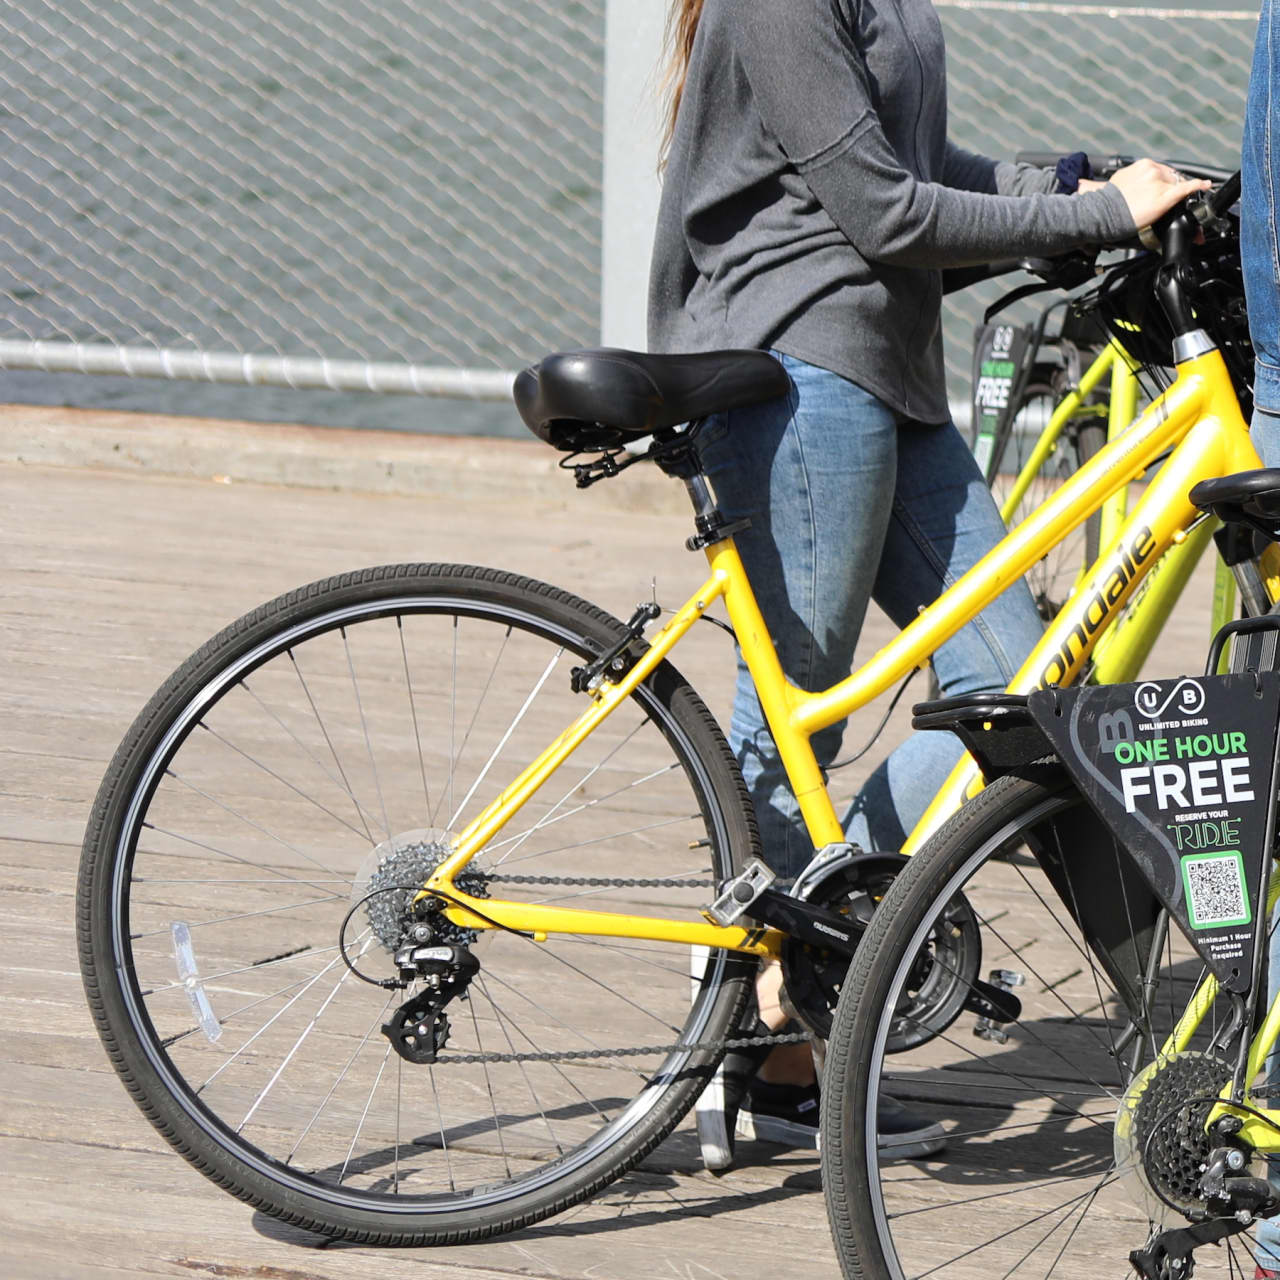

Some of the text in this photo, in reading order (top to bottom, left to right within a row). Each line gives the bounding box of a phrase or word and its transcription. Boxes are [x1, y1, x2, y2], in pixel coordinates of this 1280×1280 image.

[974, 375, 1013, 408] FREE
[1143, 689, 1197, 708] U B
[1138, 718, 1209, 731] UNLIMITED BIKING
[1114, 731, 1248, 764] ONE HOUR
[1120, 756, 1255, 814] FREE
[1175, 809, 1229, 822] RESERVE YOUR
[1168, 817, 1242, 850] RIDE
[1197, 936, 1229, 945] Minimum
[1210, 942, 1242, 952] Purchase
[1211, 950, 1244, 960] Required
